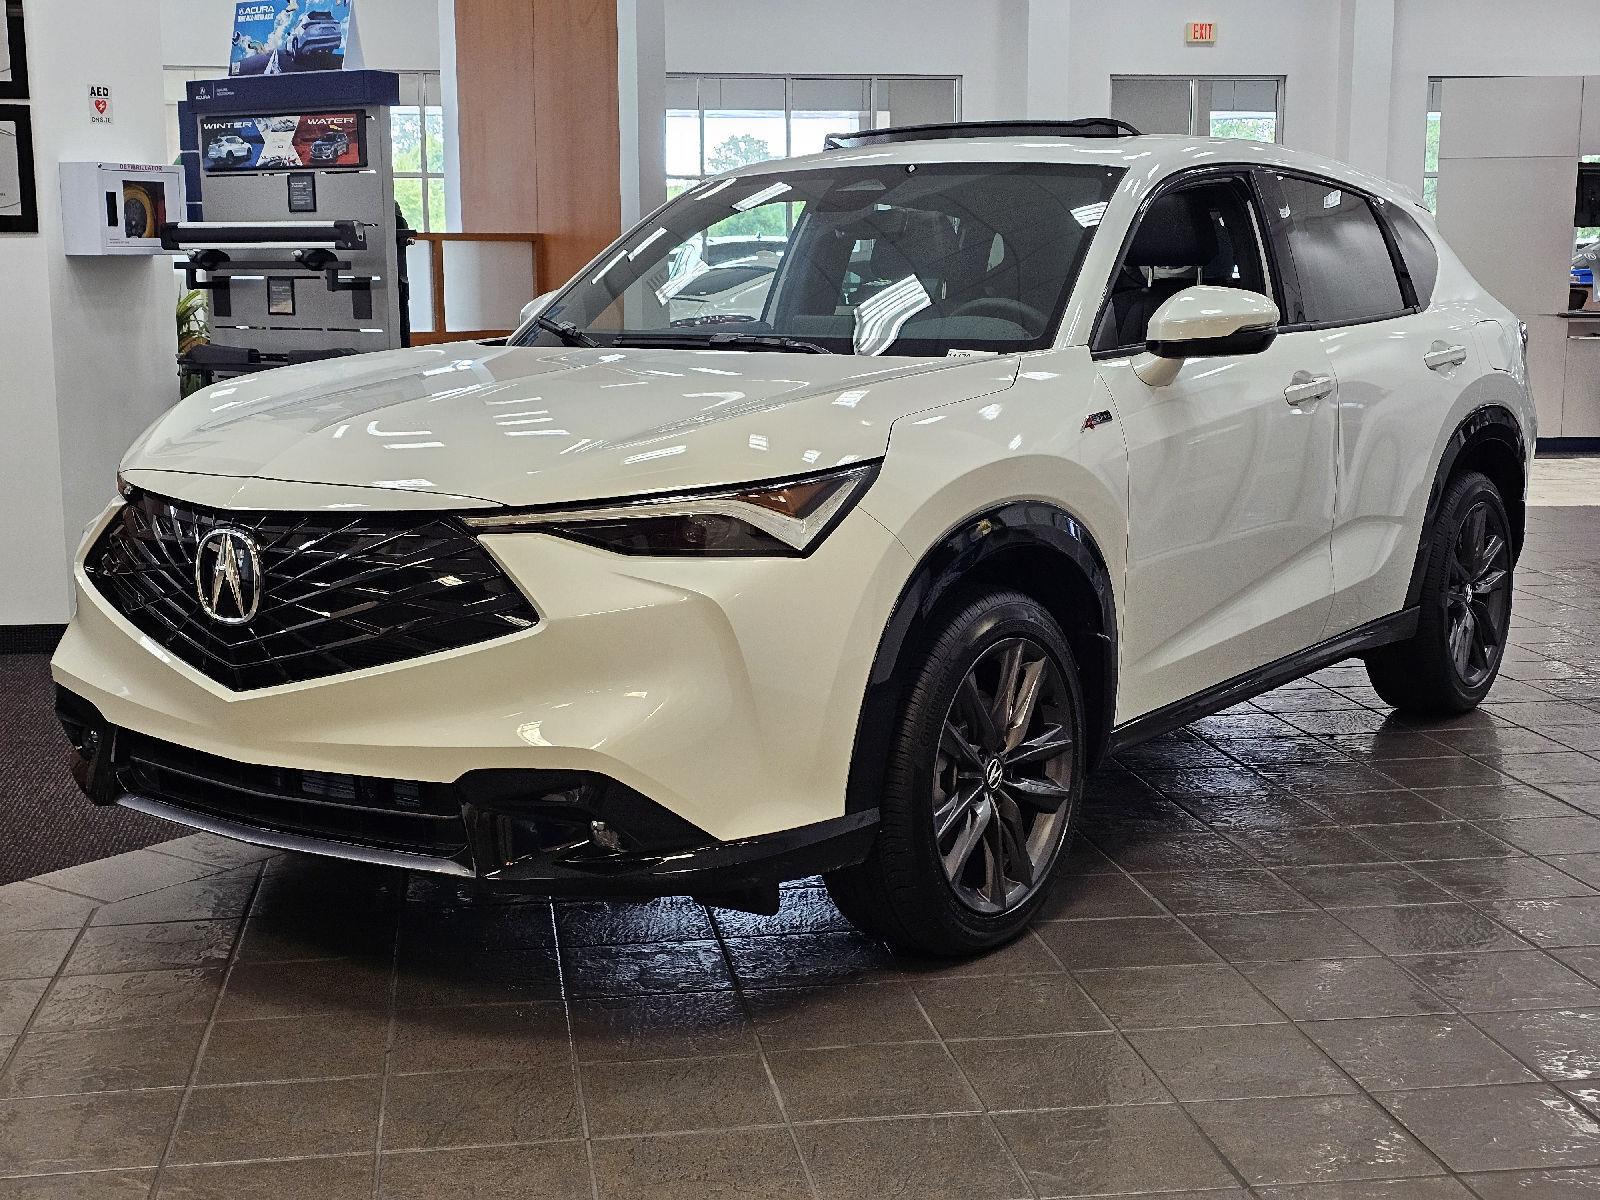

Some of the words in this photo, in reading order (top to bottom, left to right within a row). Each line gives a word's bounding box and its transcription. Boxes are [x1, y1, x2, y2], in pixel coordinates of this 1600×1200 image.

[244, 5, 275, 15] ACURA
[1192, 23, 1213, 40] EXIT
[89, 86, 109, 97] AED
[203, 121, 253, 130] WINTER
[307, 117, 354, 125] WATER
